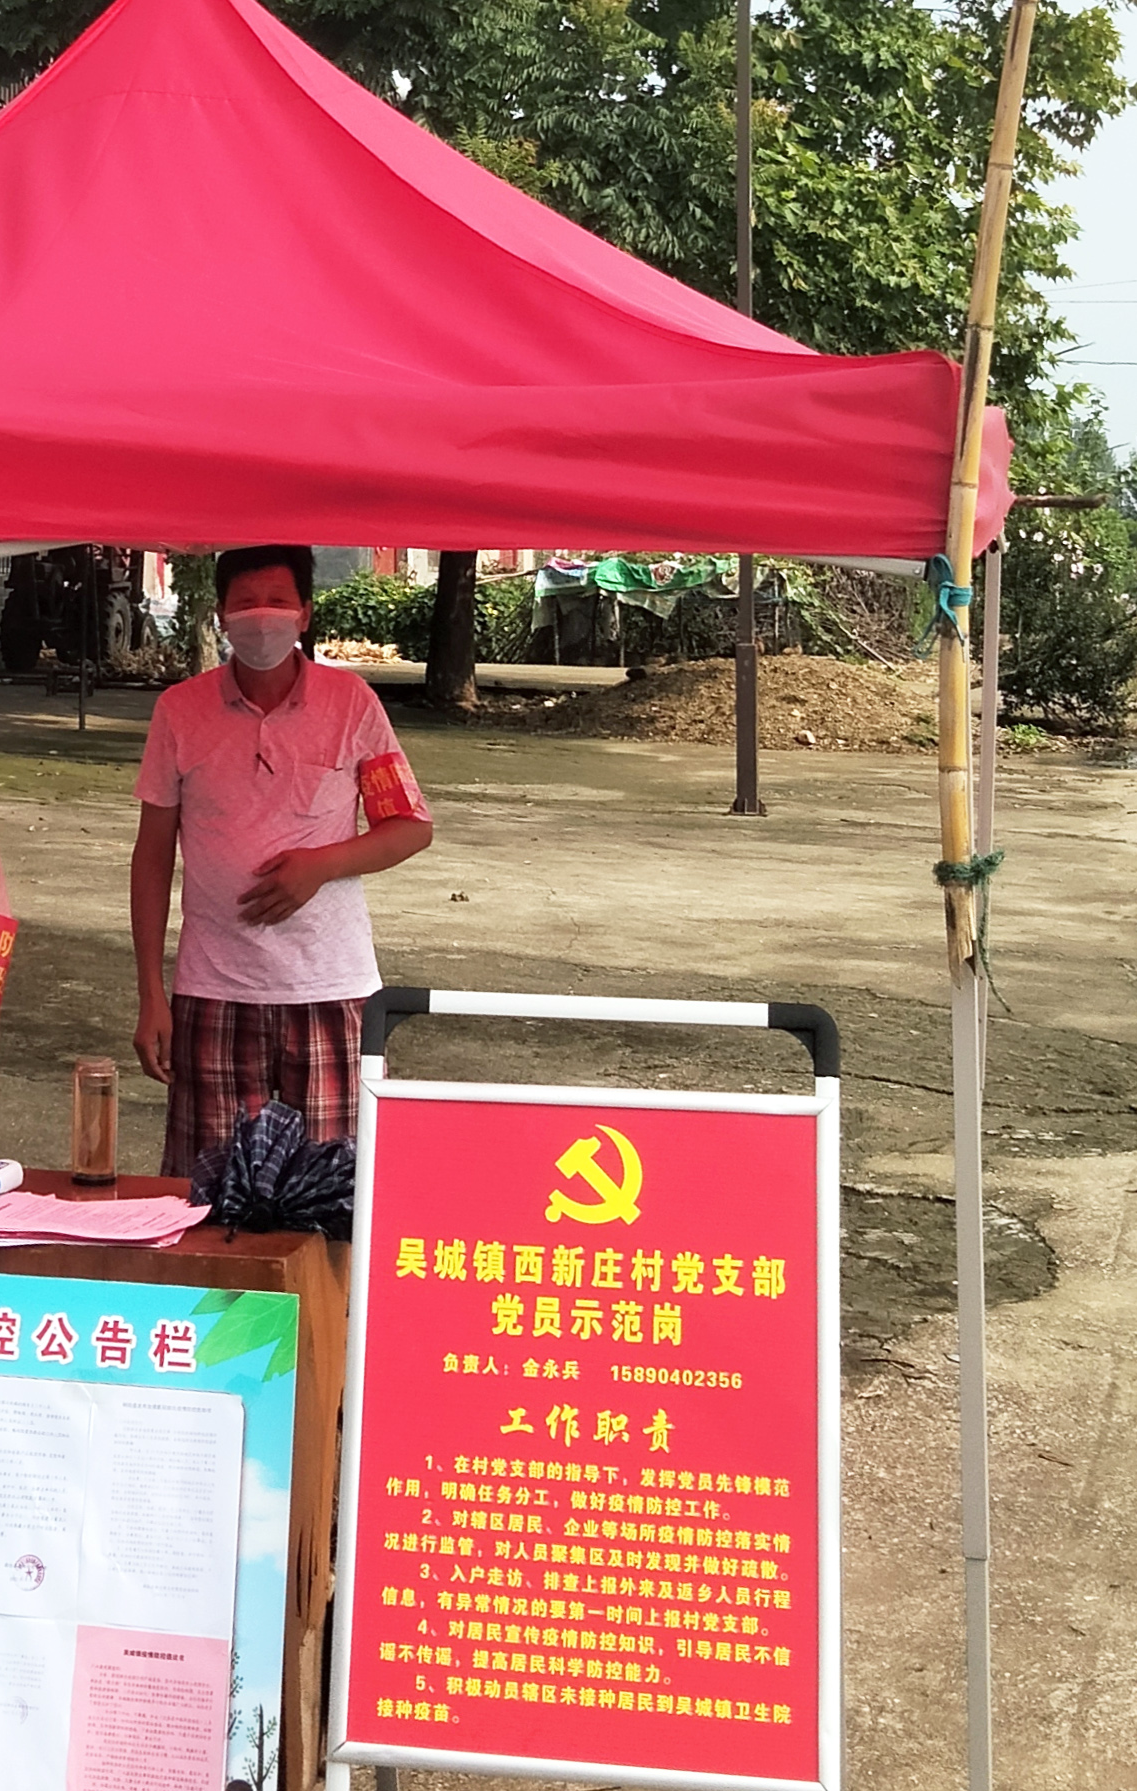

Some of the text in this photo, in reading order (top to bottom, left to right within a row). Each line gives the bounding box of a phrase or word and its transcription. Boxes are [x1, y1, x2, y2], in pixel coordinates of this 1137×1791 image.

[395, 1237, 786, 1299] 吴城镇西新庄村党支部
[491, 1292, 682, 1346] 党员示范岗
[443, 1352, 742, 1389] 负责人：金永兵 15890402356
[499, 1403, 673, 1452] 工作职责
[386, 1477, 731, 1520] 作用，明确任务分工，做好疫情防控工作。
[426, 1454, 789, 1498] 1、在村党支部的指导下，发挥党员先锋模范
[383, 1532, 790, 1582] 况进行监管，对人员聚集区及时发现并做好疏散。
[420, 1563, 791, 1610] 3、入户走访、排查上报外来及返乡人员行程
[381, 1586, 770, 1636] 信息，有异常情况的要第一时间上报村党支部。
[379, 1642, 672, 1684] 谣不传谣，提高居民科学防控能力。
[417, 1619, 791, 1667] 4、对居民宣传疫情防控知识，引导居民不信
[376, 1697, 461, 1723] 接种疫苗。
[415, 1674, 791, 1724] 5、积极动员辖区未接种居民到吴城镇卫生院
